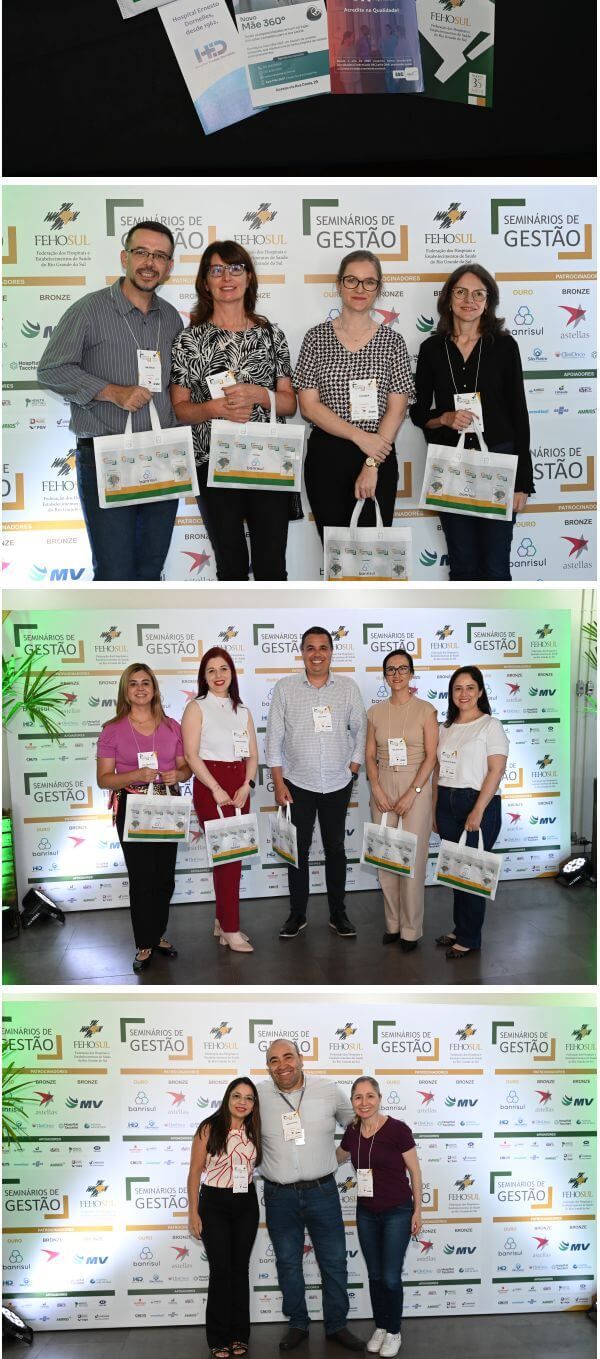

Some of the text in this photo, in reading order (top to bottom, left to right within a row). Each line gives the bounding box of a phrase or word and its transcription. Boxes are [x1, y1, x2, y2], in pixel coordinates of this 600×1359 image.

[172, 2, 220, 22] Hospital Ernesto
[431, 12, 471, 26] FEHOSUL
[186, 26, 203, 35] desde
[242, 20, 261, 30] Mãe
[189, 216, 202, 226] DE
[316, 213, 394, 226] SEMINÁRIOS DE
[504, 213, 579, 224] SEMINÁRIOS DE
[35, 235, 90, 246] FEHOSUL
[234, 234, 287, 245] FEHOSUL
[317, 227, 396, 248] GESTÃO
[425, 233, 476, 244] FEHOSUL
[504, 226, 580, 247] GESTÃO
[512, 326, 544, 336] anrisul
[560, 329, 590, 339] astellas
[562, 560, 592, 569] astellas
[50, 568, 85, 581] MV
[23, 632, 64, 641] SEMINÁRIOS
[474, 630, 506, 638] SEMINÁRIOS
[24, 642, 76, 656] GESTÃO
[146, 641, 195, 655] GESTÃO
[474, 638, 516, 650] GESTÃO
[34, 788, 85, 803] GESTÃO
[130, 1027, 171, 1036] SEMINÁRIOS
[381, 1030, 420, 1038] SEMINÁRIOS
[74, 1040, 110, 1049] FEHOSUL
[130, 1037, 184, 1052] GESTÃO
[382, 1039, 432, 1053] GESTÃO
[500, 1039, 548, 1053] GESTÃO
[80, 1100, 103, 1108] MV
[457, 1098, 478, 1107] MV
[498, 1187, 545, 1202] GESTÃO
[5, 1196, 60, 1212] GESTÃO
[456, 1246, 476, 1254] MV
